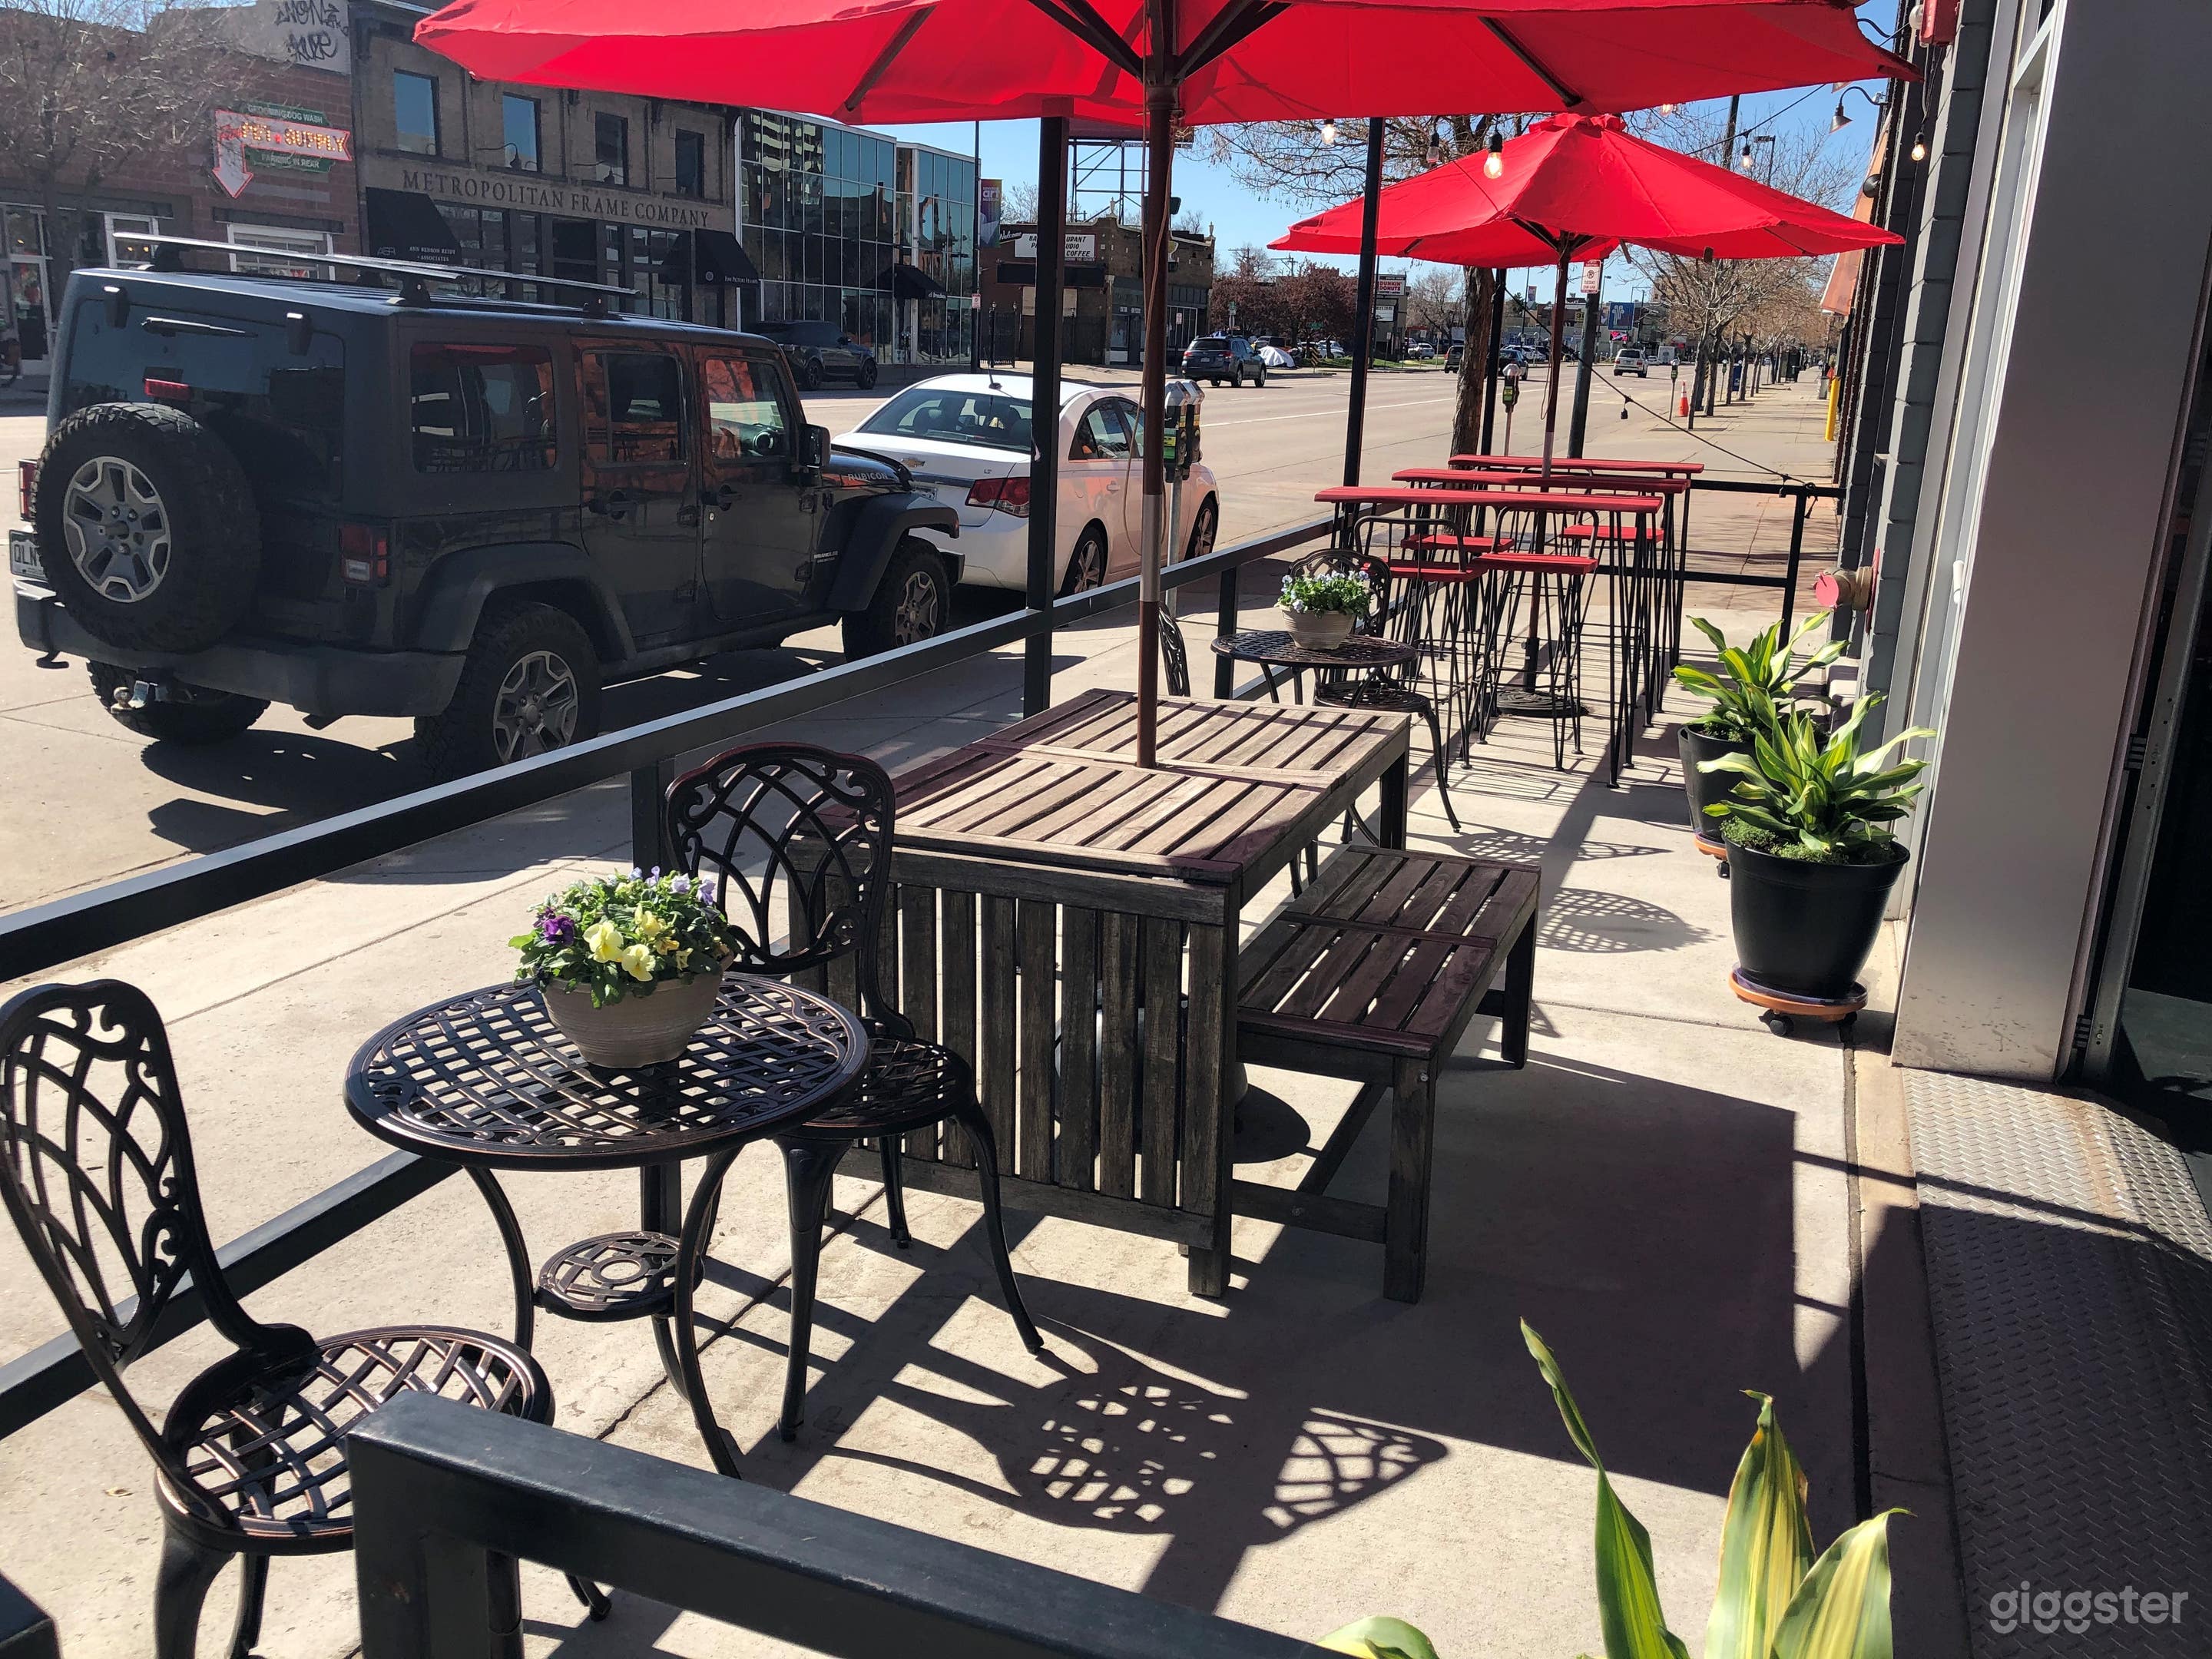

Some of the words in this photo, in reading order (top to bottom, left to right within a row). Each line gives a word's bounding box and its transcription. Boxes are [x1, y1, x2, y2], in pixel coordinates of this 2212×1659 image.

[303, 114, 323, 124] WASH
[241, 122, 271, 141] PET
[285, 128, 345, 152] SUPPLY
[301, 159, 320, 168] REAR
[403, 170, 563, 207] METROPOLITAN
[571, 194, 628, 217] FRAME
[635, 203, 708, 227] COMPANY
